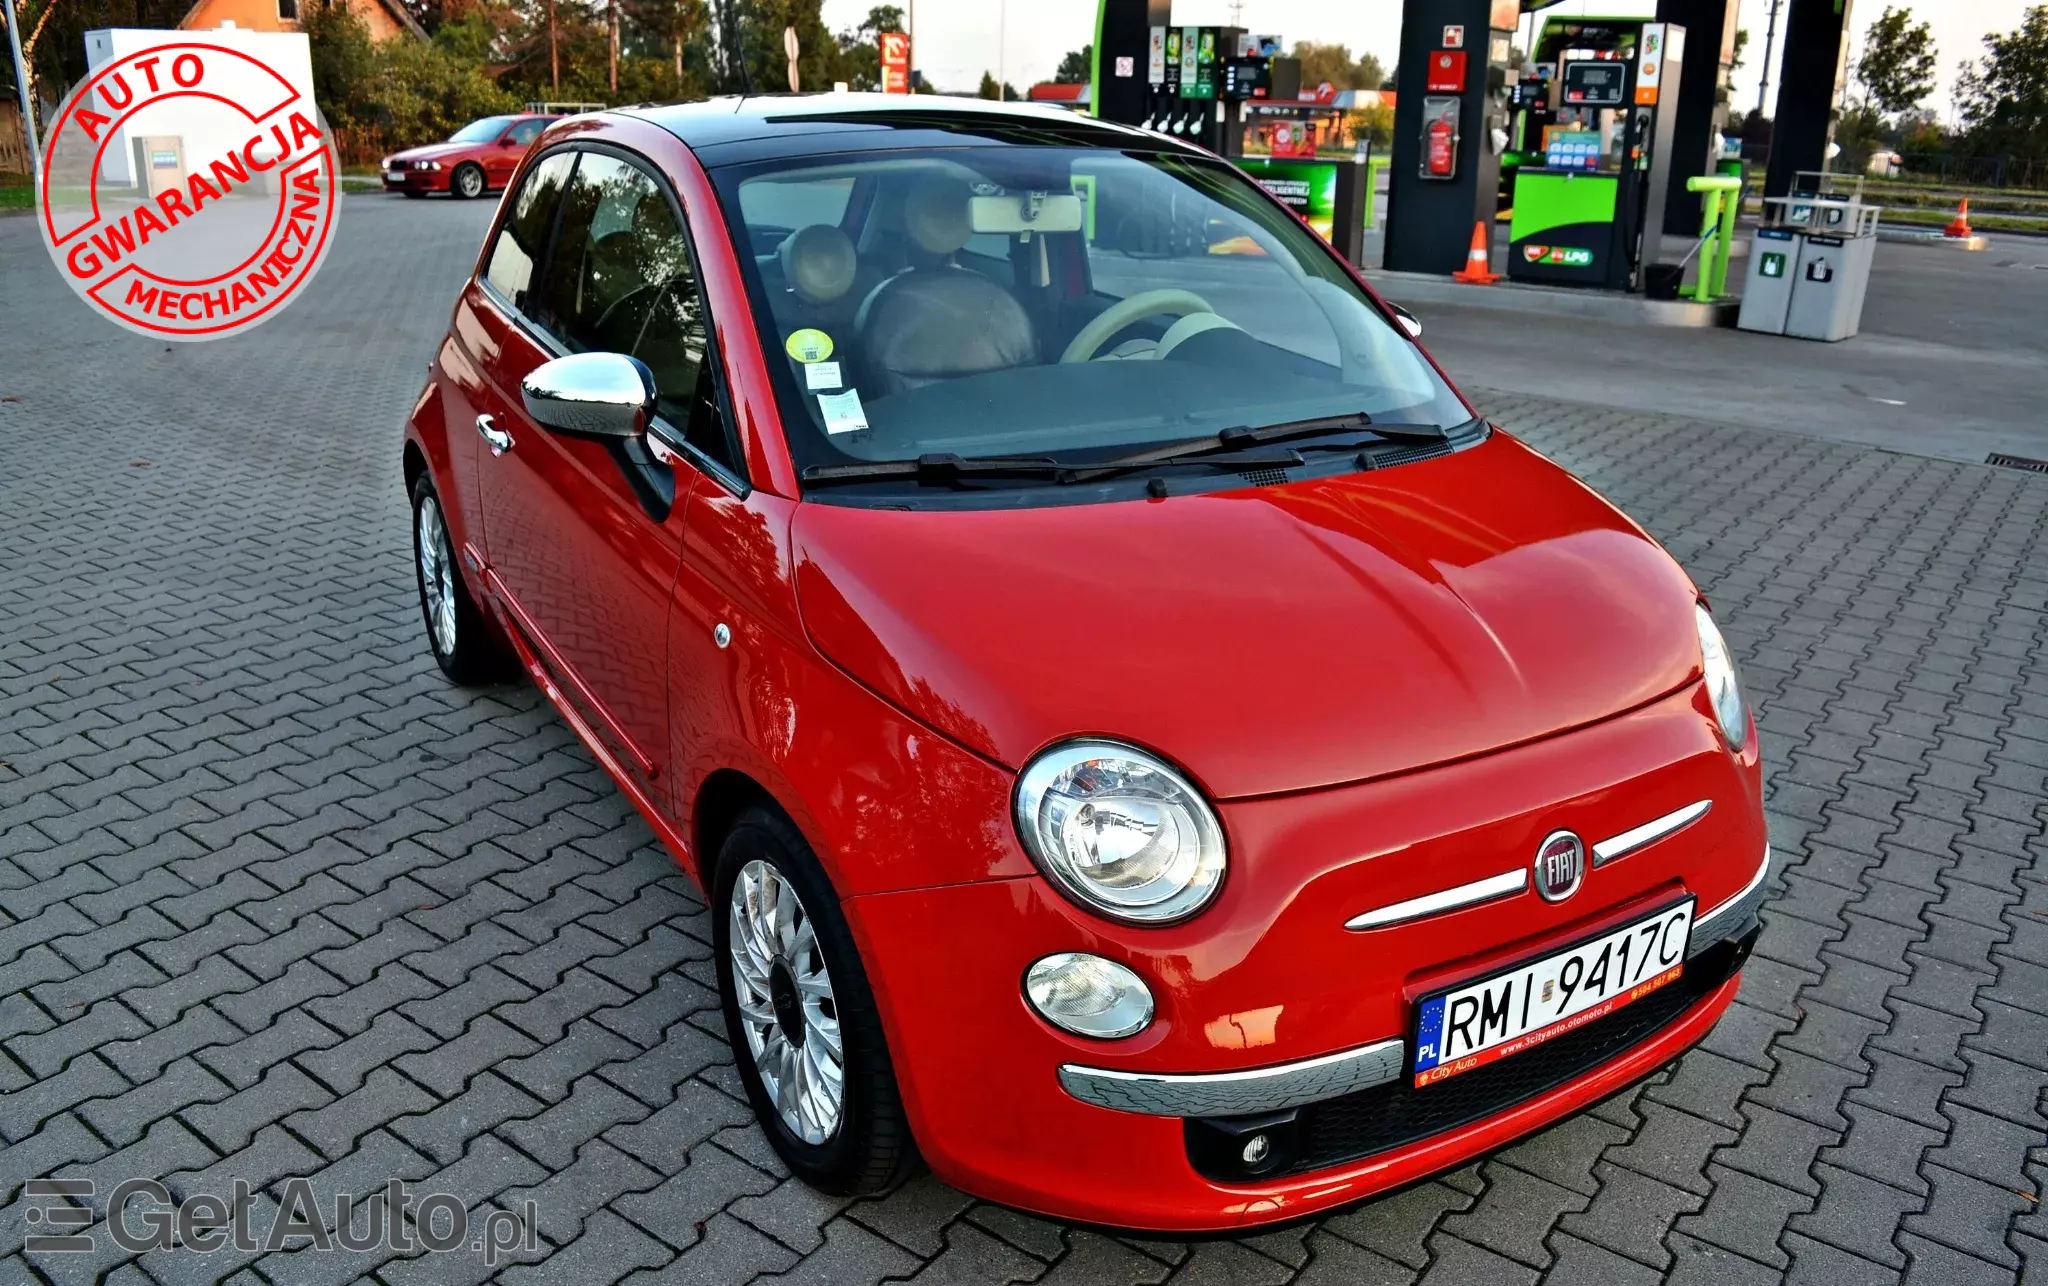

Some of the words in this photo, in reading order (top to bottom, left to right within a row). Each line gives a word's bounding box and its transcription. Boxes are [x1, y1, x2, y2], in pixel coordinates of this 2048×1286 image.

[1564, 251, 1590, 263] LPG
[1547, 849, 1576, 888] FIAT
[1444, 972, 1534, 1058] RMI
[1555, 911, 1686, 1016] 9417C
[1499, 1000, 1613, 1056] www.3cityauto.otomoto.pl
[1417, 1042, 1437, 1062] PL
[1431, 1064, 1453, 1080] City
[1453, 1057, 1478, 1073] Auto
